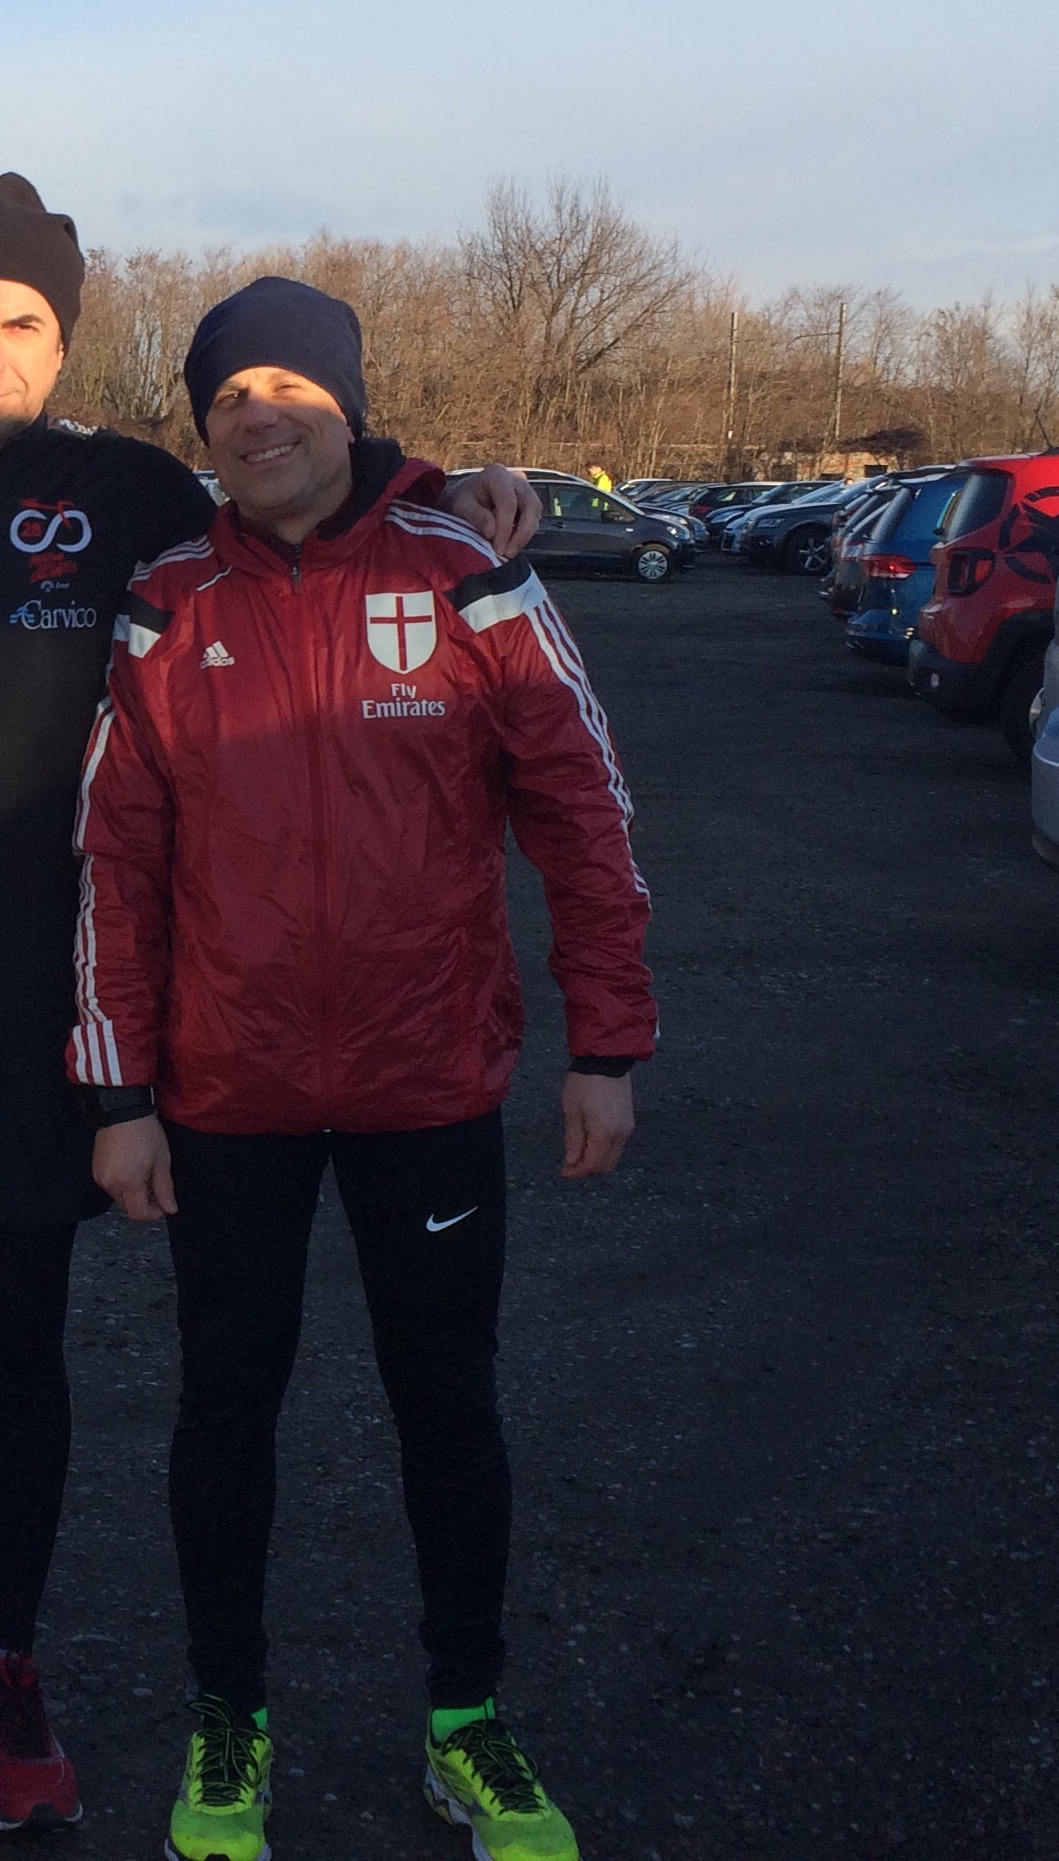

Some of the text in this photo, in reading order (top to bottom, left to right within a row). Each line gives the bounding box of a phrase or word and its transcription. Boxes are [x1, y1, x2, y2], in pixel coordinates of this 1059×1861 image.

[21, 600, 97, 630] Carvico
[390, 683, 417, 699] Fly
[361, 697, 445, 718] Emirates
